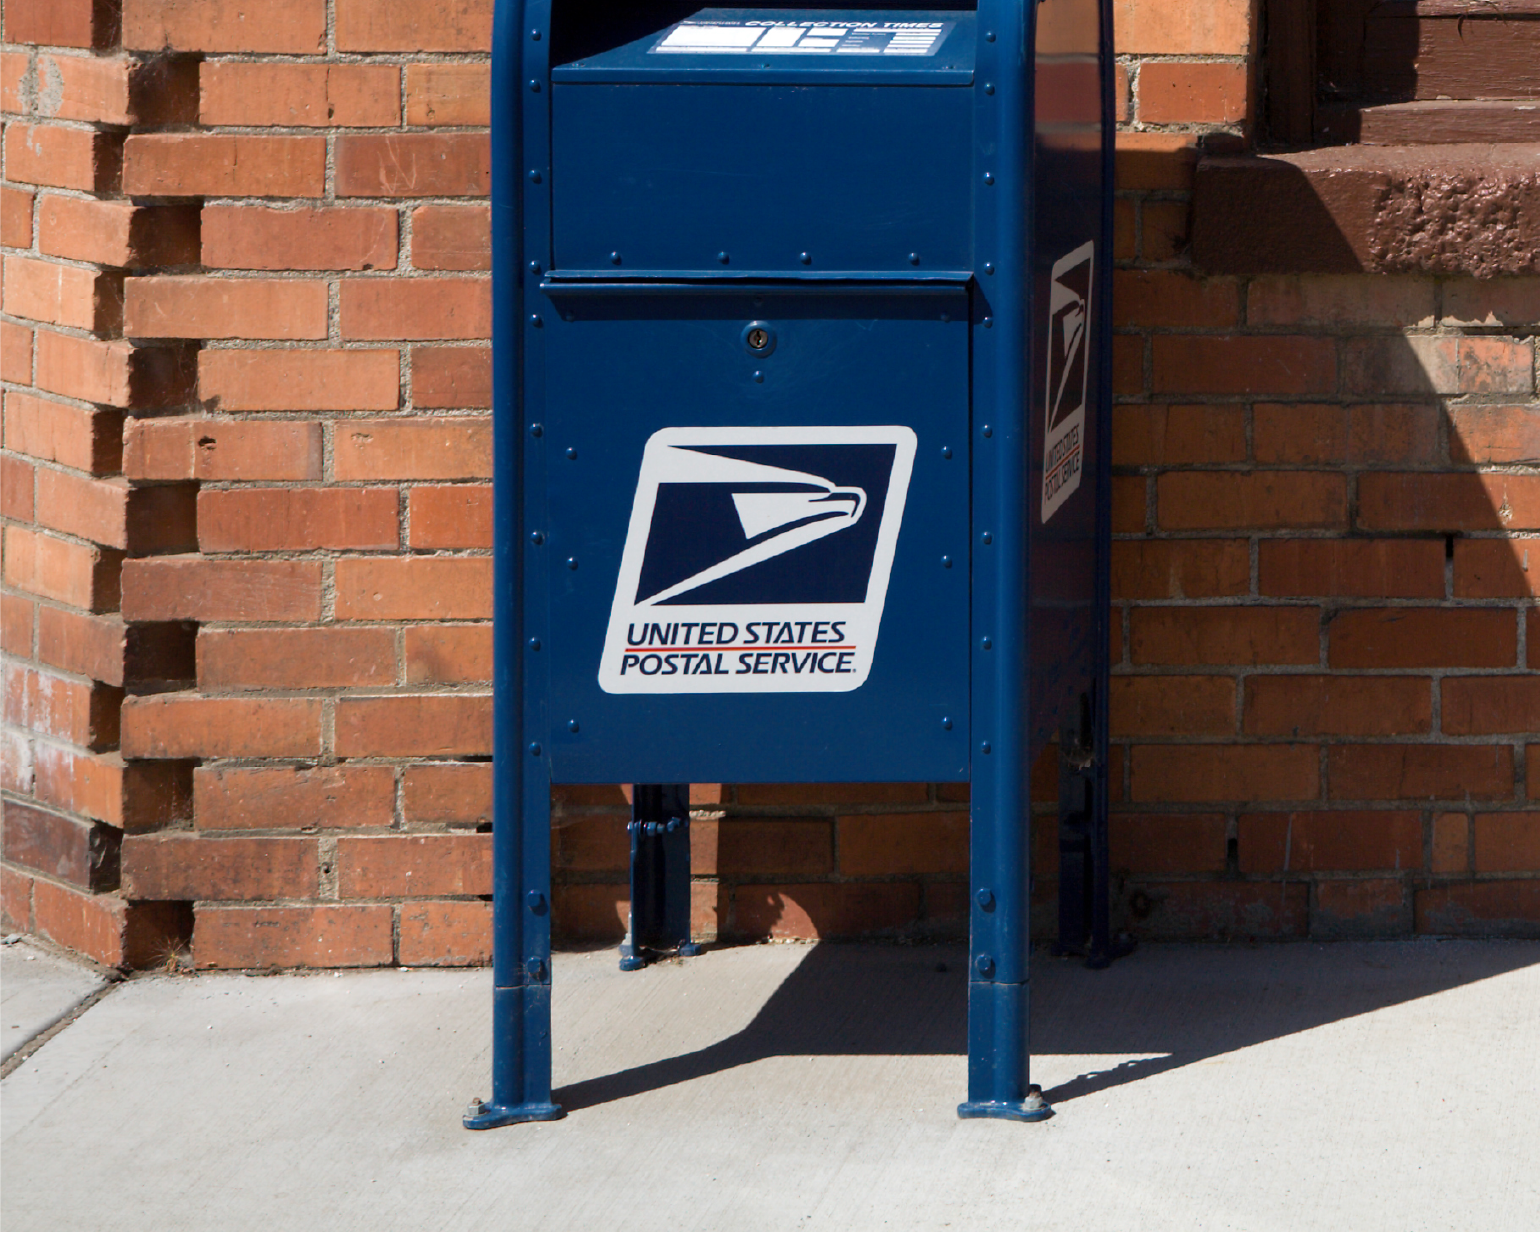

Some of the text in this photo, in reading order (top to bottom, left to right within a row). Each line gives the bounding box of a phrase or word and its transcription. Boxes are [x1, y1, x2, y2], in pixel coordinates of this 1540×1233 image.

[744, 20, 878, 28] COLLECTION
[627, 621, 846, 646] UNITED STATES
[620, 653, 730, 676] POSTAL
